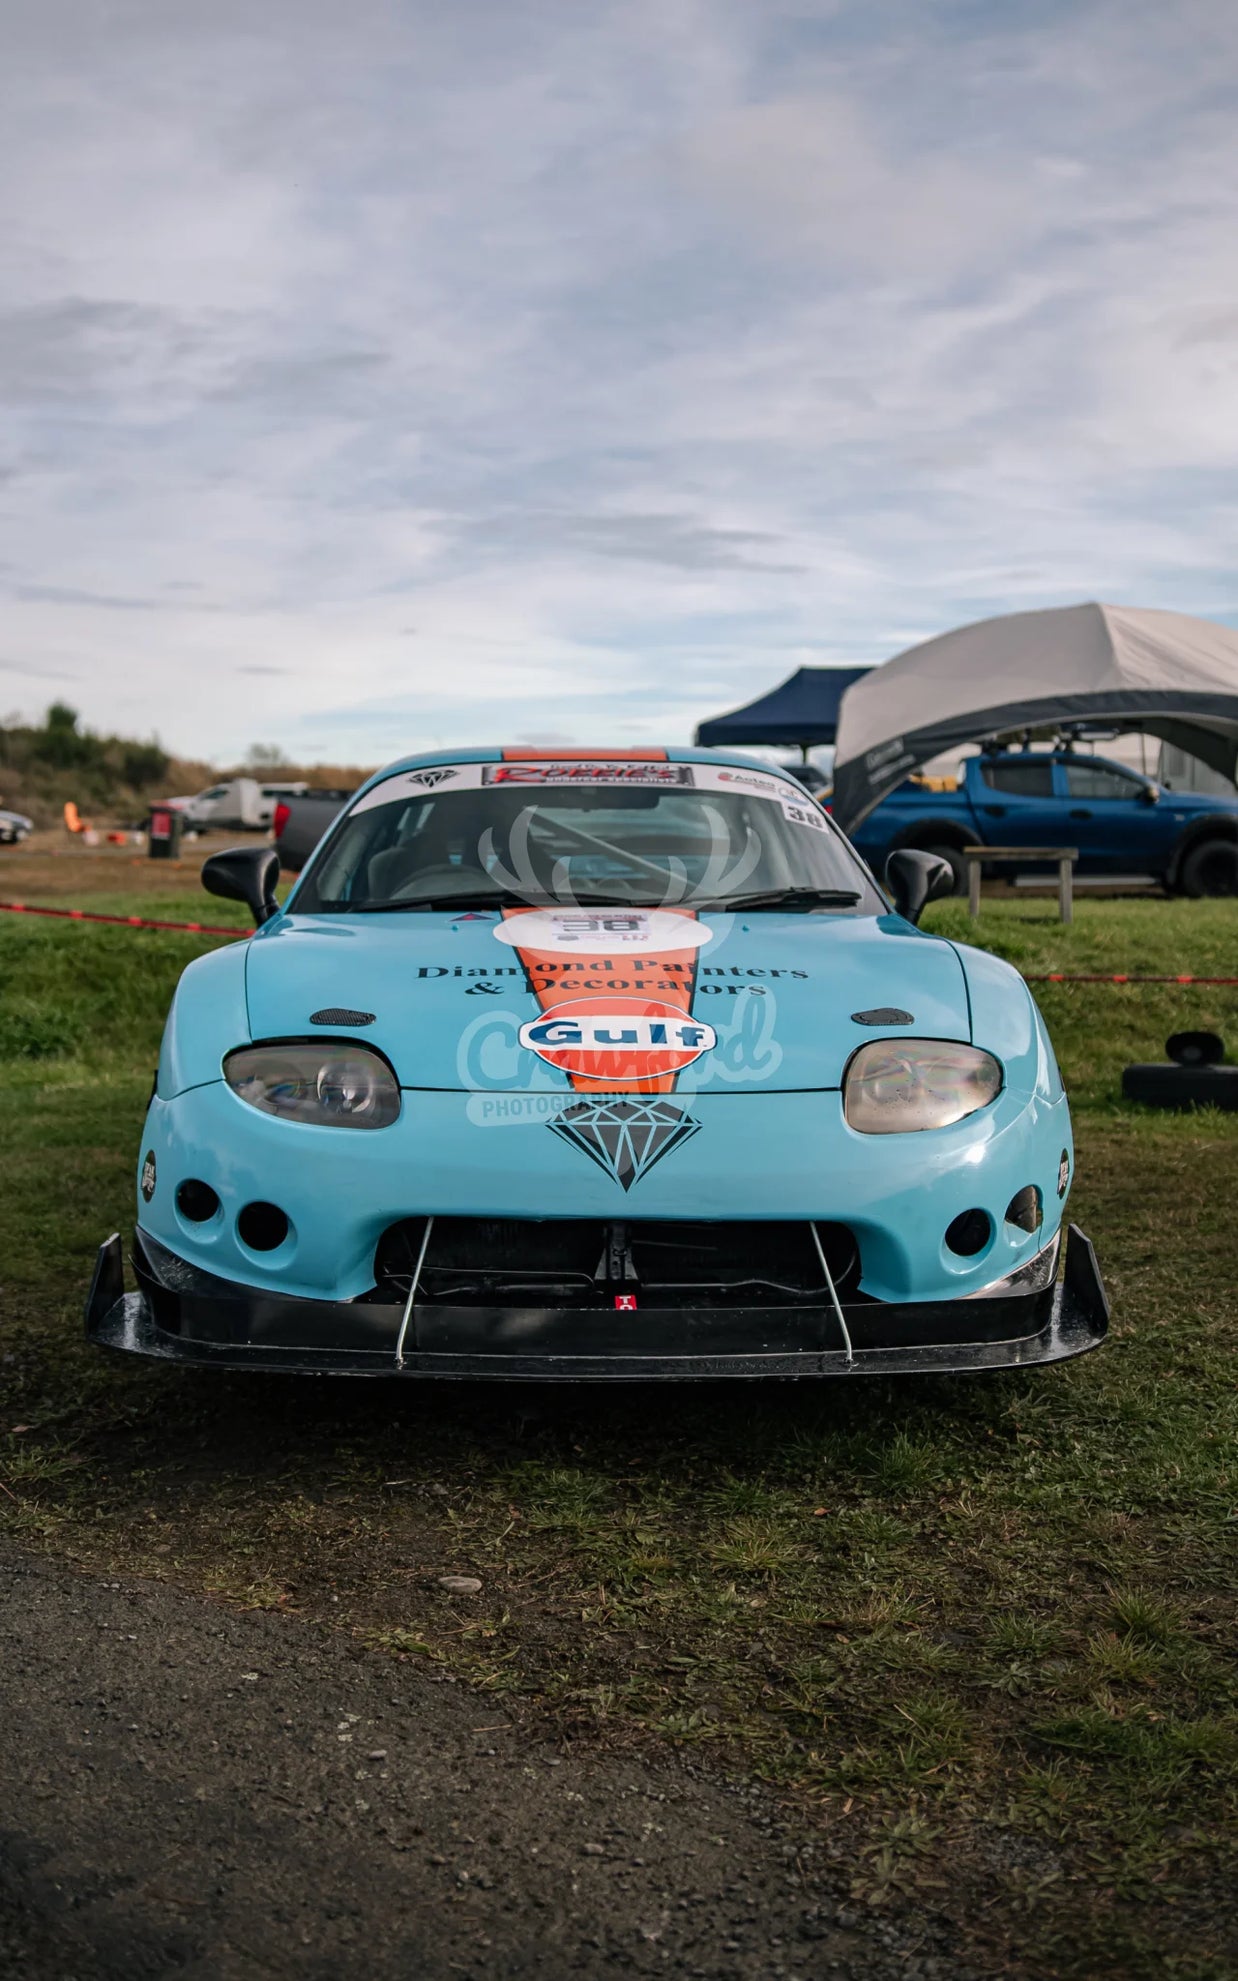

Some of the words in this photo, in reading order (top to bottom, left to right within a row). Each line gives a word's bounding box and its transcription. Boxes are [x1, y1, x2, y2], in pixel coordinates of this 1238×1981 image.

[562, 919, 640, 932] 38
[416, 960, 616, 979] Diamond
[631, 960, 809, 979] Painters
[465, 982, 505, 995] &
[521, 979, 767, 996] Decorators
[528, 1021, 706, 1047] Gulf
